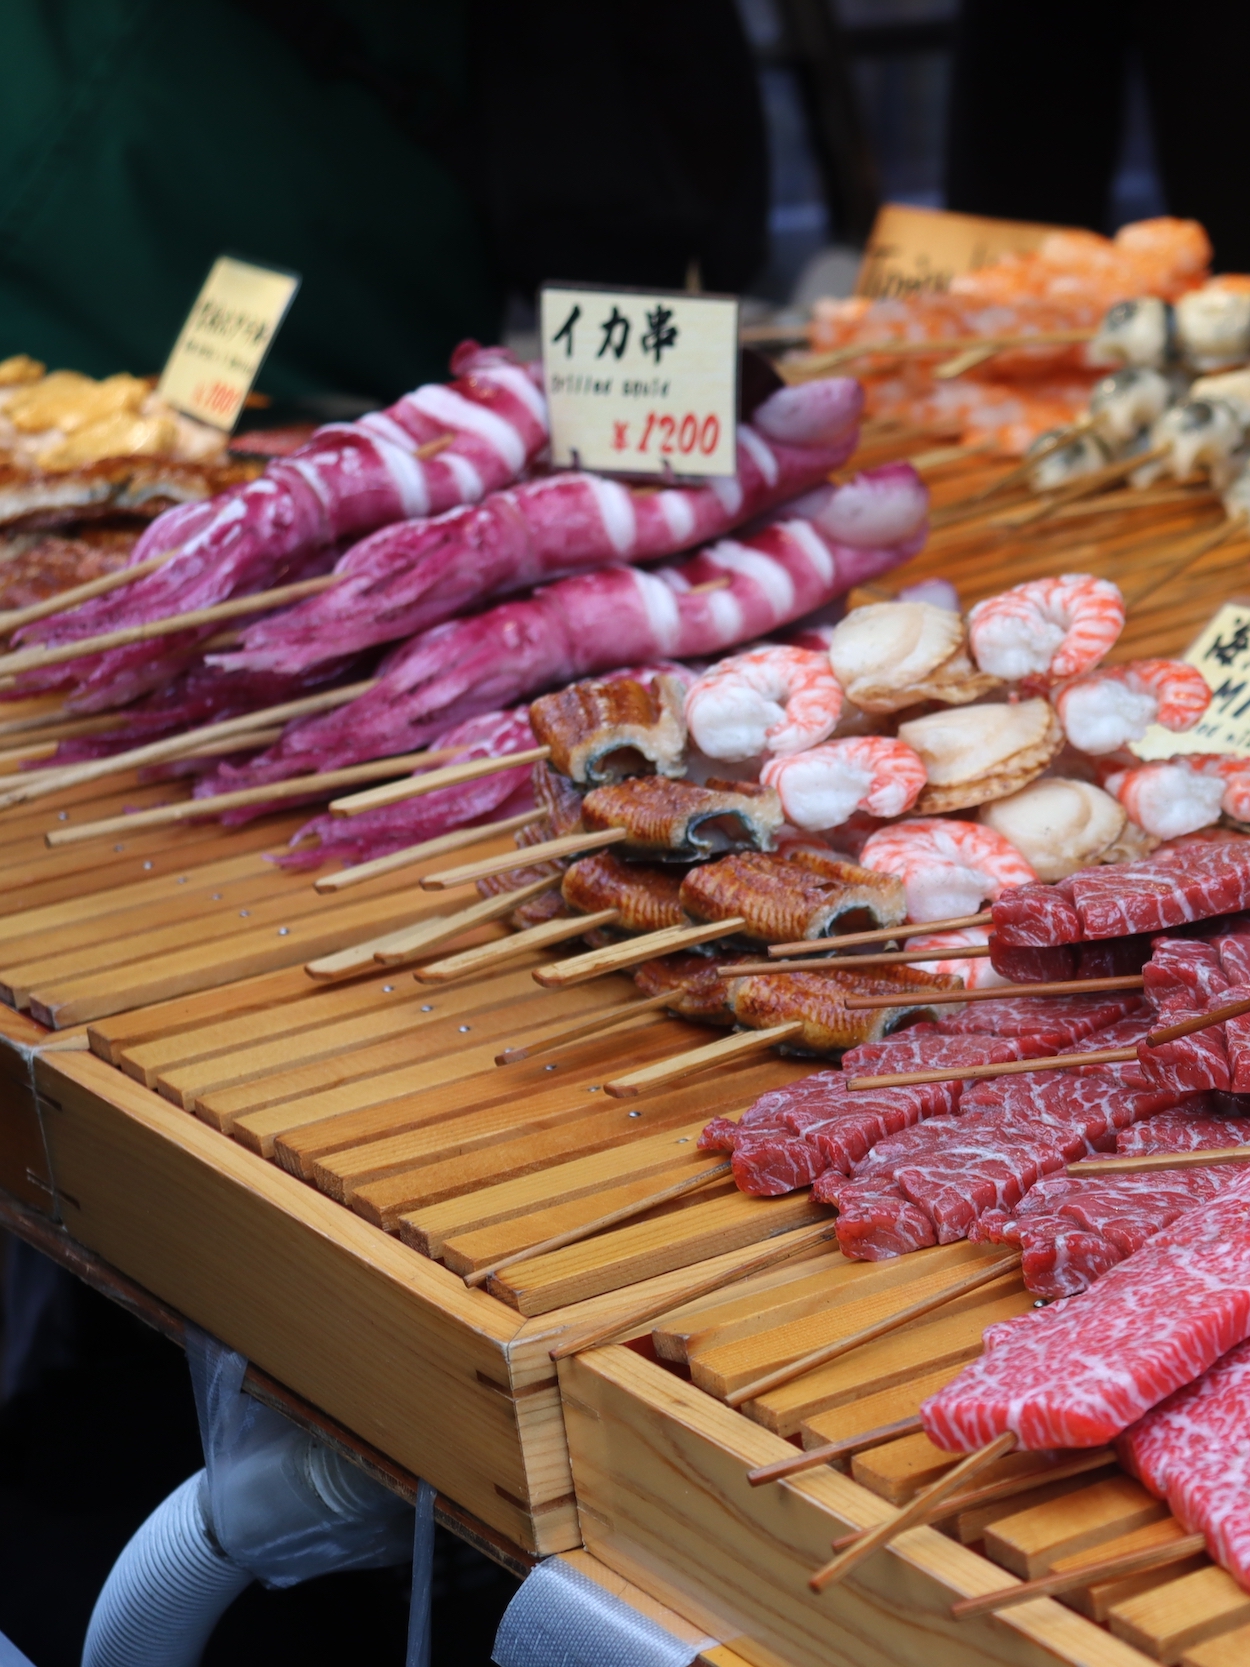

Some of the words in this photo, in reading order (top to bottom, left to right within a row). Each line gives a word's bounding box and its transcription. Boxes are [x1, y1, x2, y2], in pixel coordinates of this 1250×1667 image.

[552, 303, 678, 365] イカ串
[611, 410, 721, 456] ¥1200
